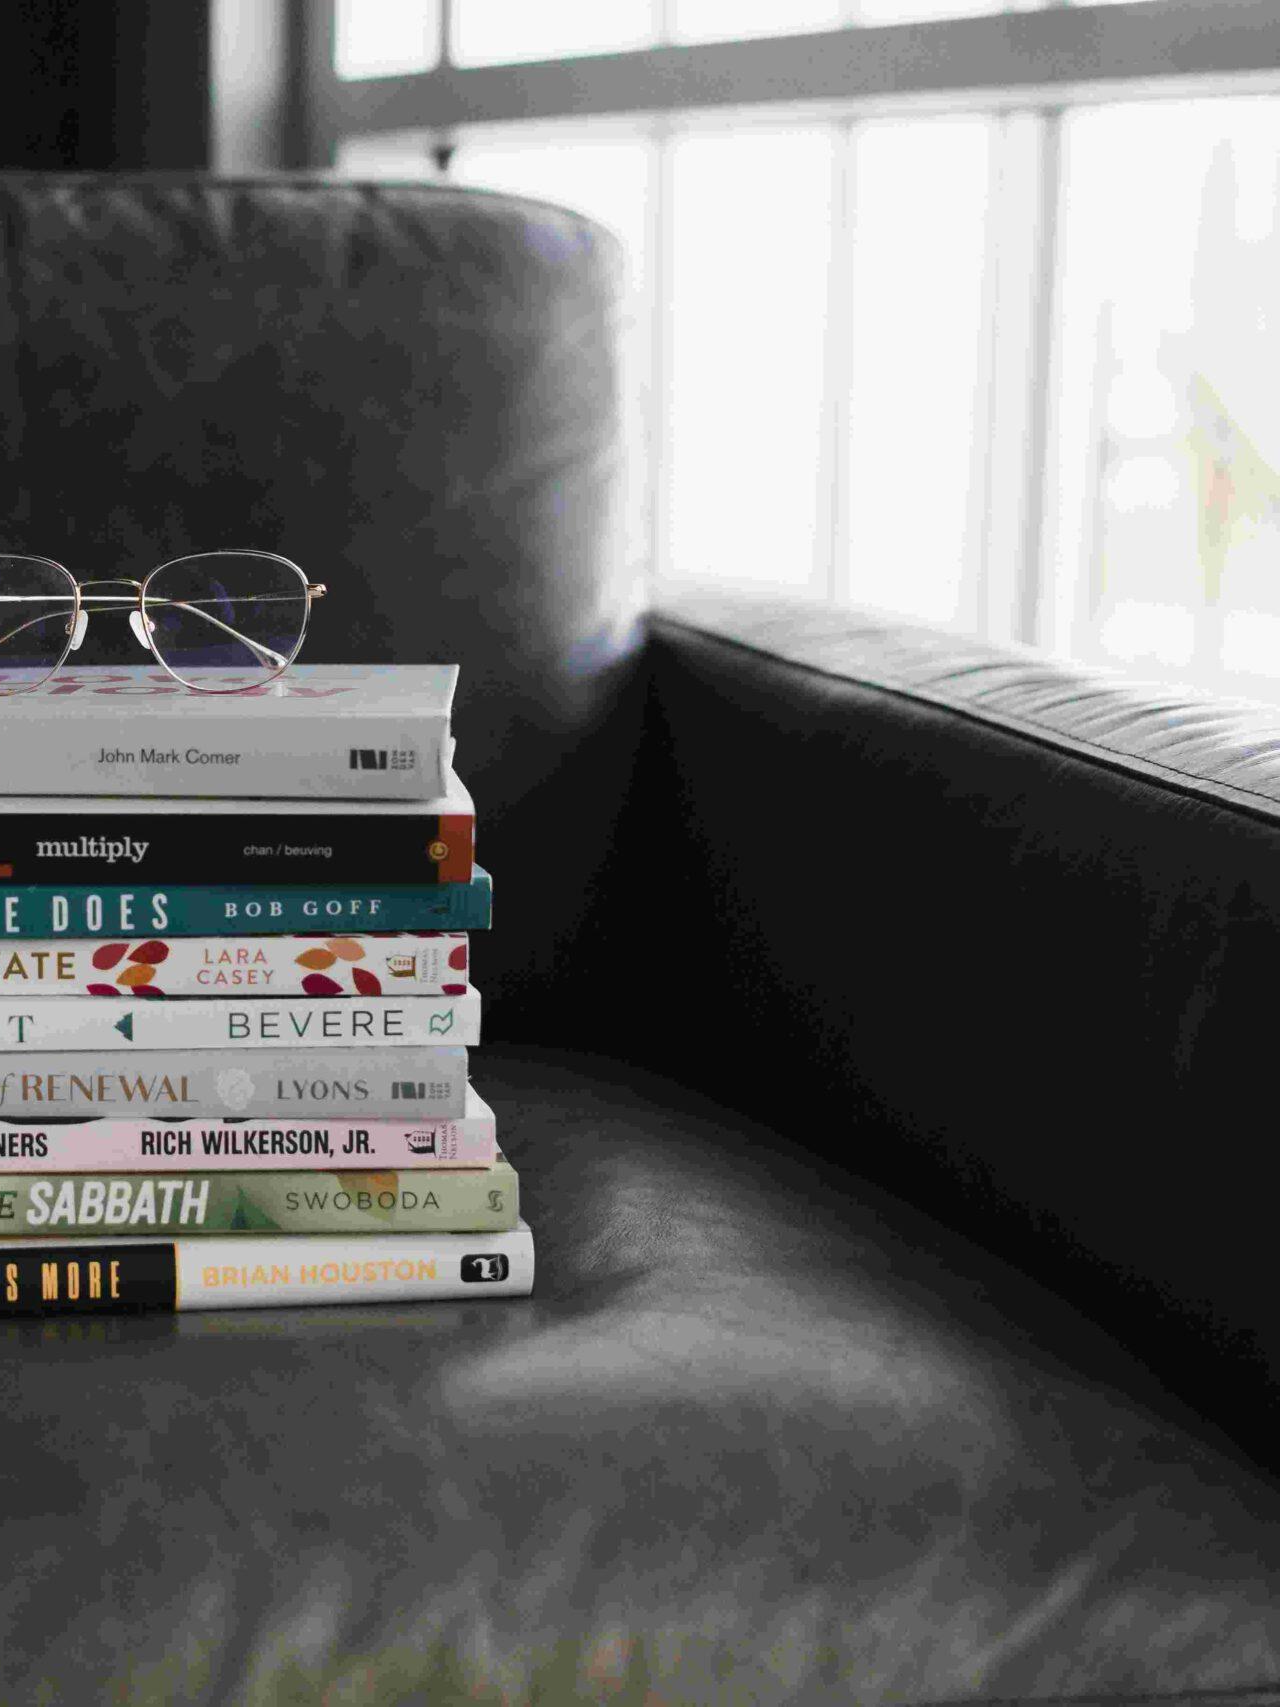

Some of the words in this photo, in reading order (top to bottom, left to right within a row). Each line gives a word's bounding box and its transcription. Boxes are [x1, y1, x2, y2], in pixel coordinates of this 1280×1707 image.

[98, 748, 135, 764] John
[140, 748, 180, 765] Mark
[185, 749, 240, 765] Comer
[37, 837, 148, 863] multiply
[243, 845, 274, 856] chan
[284, 844, 333, 858] beuving
[53, 893, 168, 931] DOES
[224, 901, 283, 918] BOB
[303, 899, 382, 916] GOFF
[204, 949, 268, 965] LARA
[197, 969, 273, 985] CASEY
[228, 1010, 404, 1039] BEVERE
[21, 1074, 199, 1103] RENEWAL
[276, 1079, 370, 1101] LYONS
[142, 1131, 191, 1155] RICH
[202, 1130, 334, 1157] WILKERSON,
[343, 1130, 375, 1154] JR.
[26, 1180, 210, 1226] SABBATH
[286, 1190, 440, 1211] SWOBODA
[42, 1261, 119, 1299] MORE
[202, 1264, 291, 1288] BRIAN
[300, 1258, 439, 1287] HOUSTON
